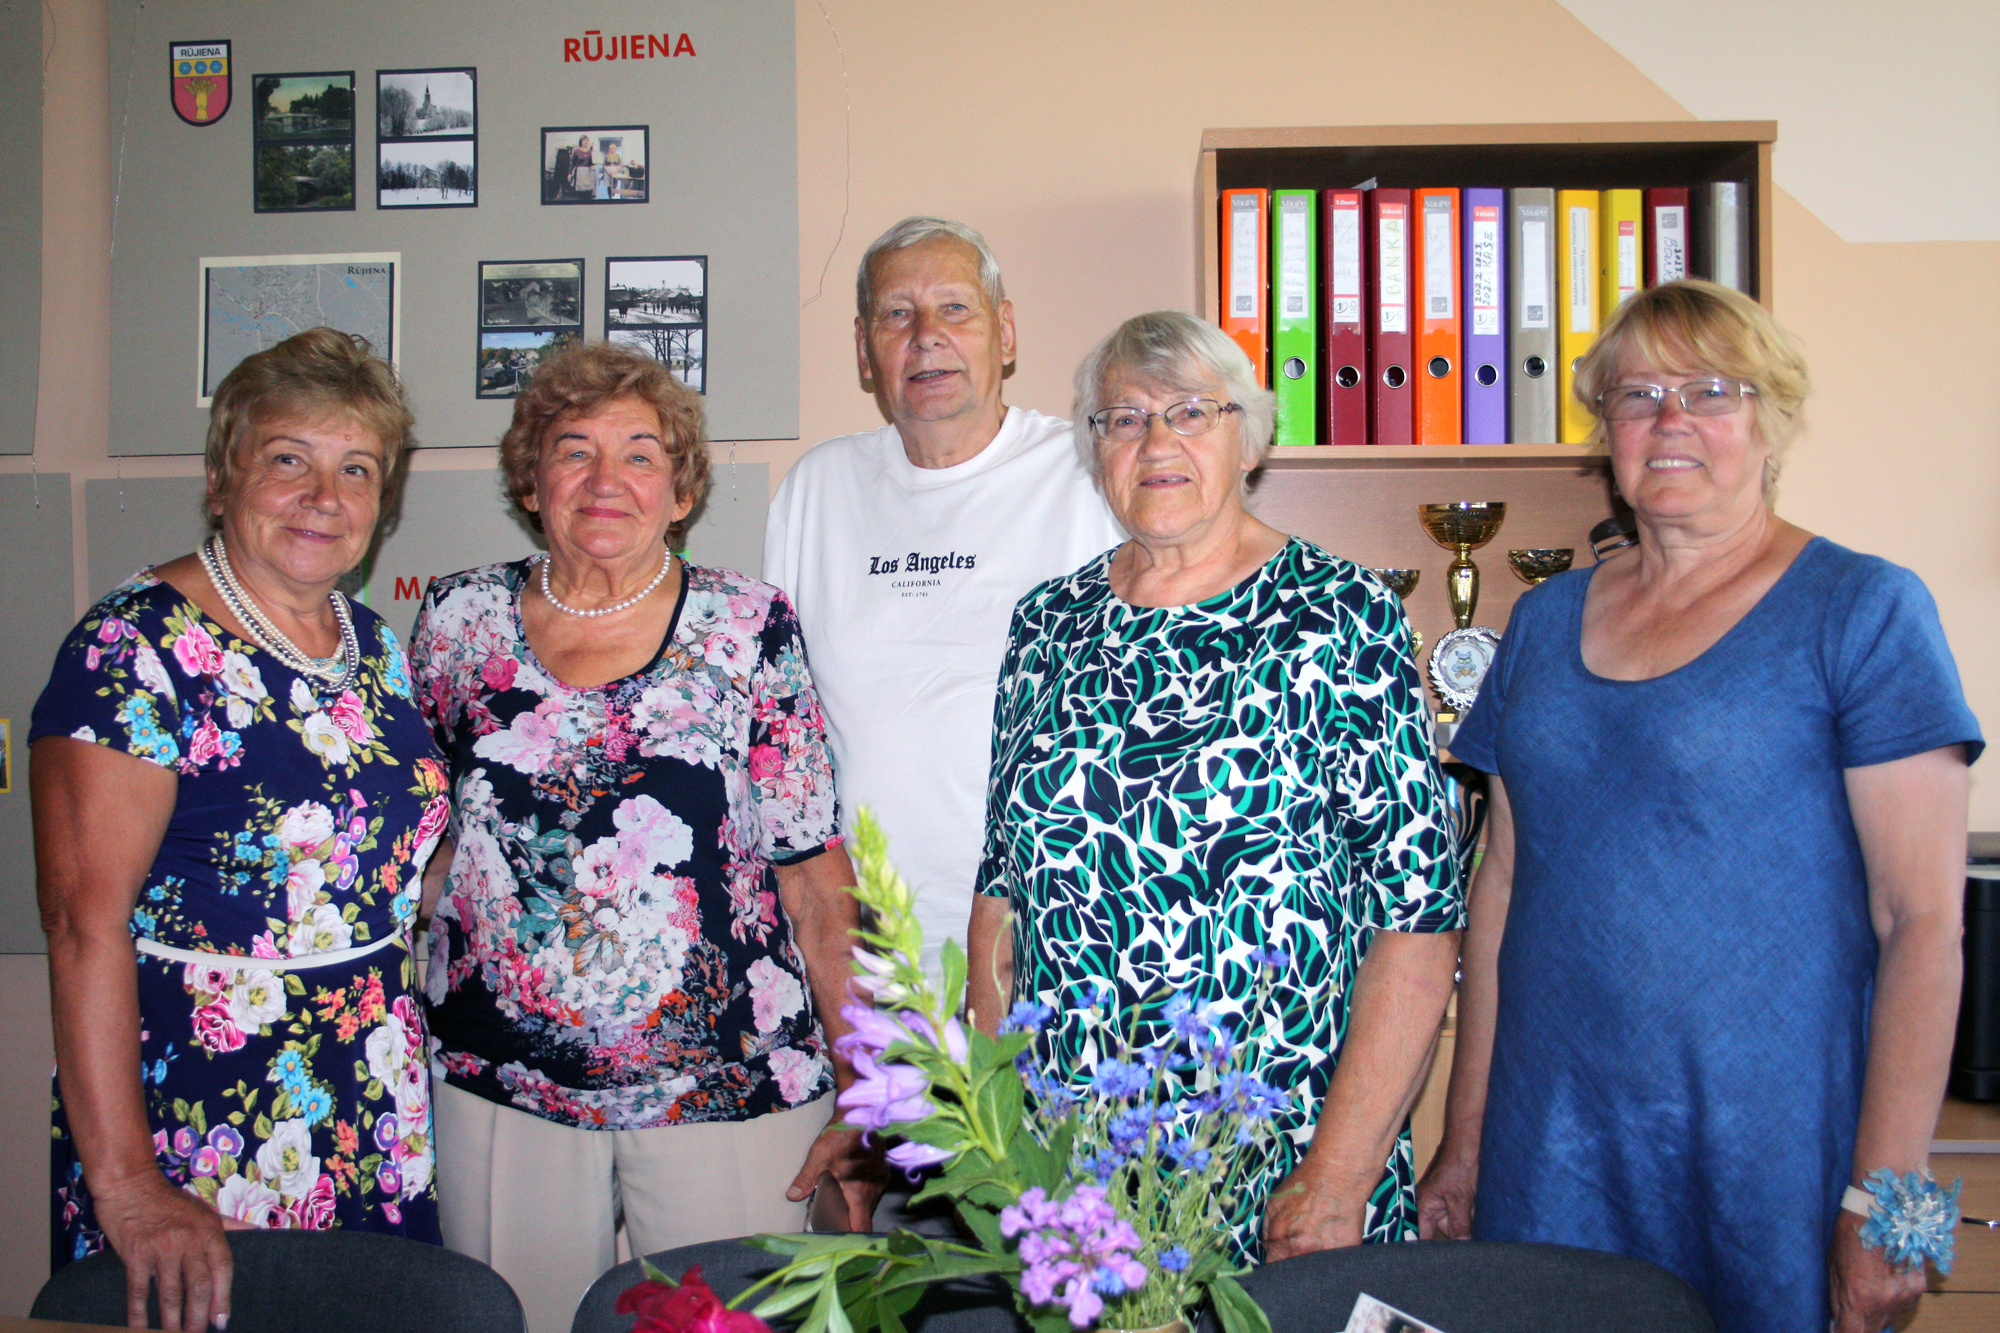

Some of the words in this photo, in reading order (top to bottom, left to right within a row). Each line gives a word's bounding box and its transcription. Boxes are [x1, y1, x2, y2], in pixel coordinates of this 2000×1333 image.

[180, 48, 221, 57] RŪJIENA
[564, 30, 696, 62] RŪJIENA
[1521, 209, 1547, 217] VauPe
[1386, 219, 1403, 297] BANKA
[868, 556, 900, 576] Los
[904, 551, 977, 575] Angeles
[891, 579, 941, 589] CALIFORNIA
